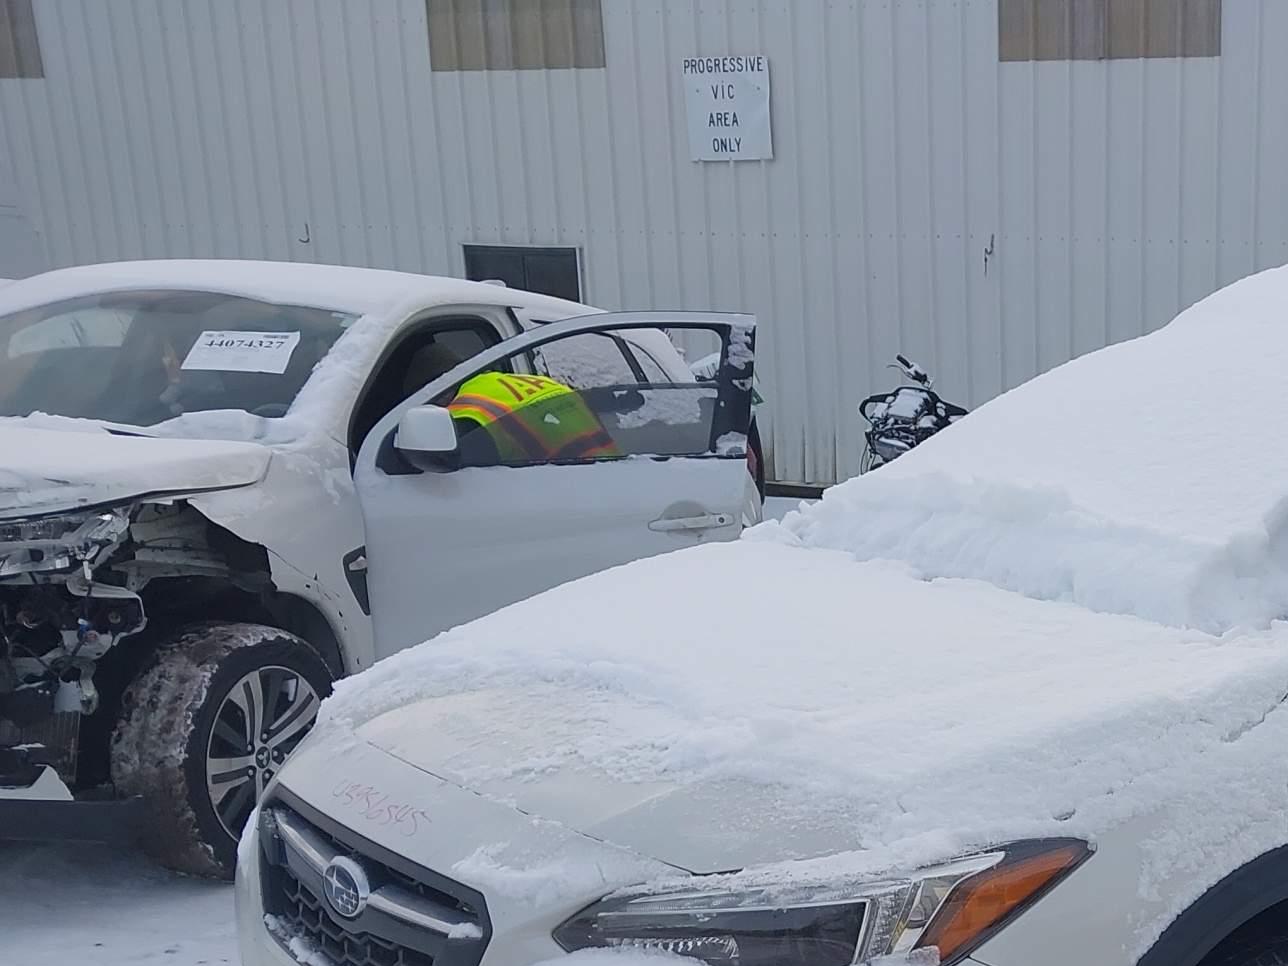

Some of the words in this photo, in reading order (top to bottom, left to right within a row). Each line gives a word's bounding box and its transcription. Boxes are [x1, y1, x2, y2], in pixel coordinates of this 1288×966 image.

[683, 57, 763, 74] PROGRESSIVE
[708, 112, 739, 127] AREA
[712, 138, 741, 152] ONLY
[203, 339, 285, 350] 44074327
